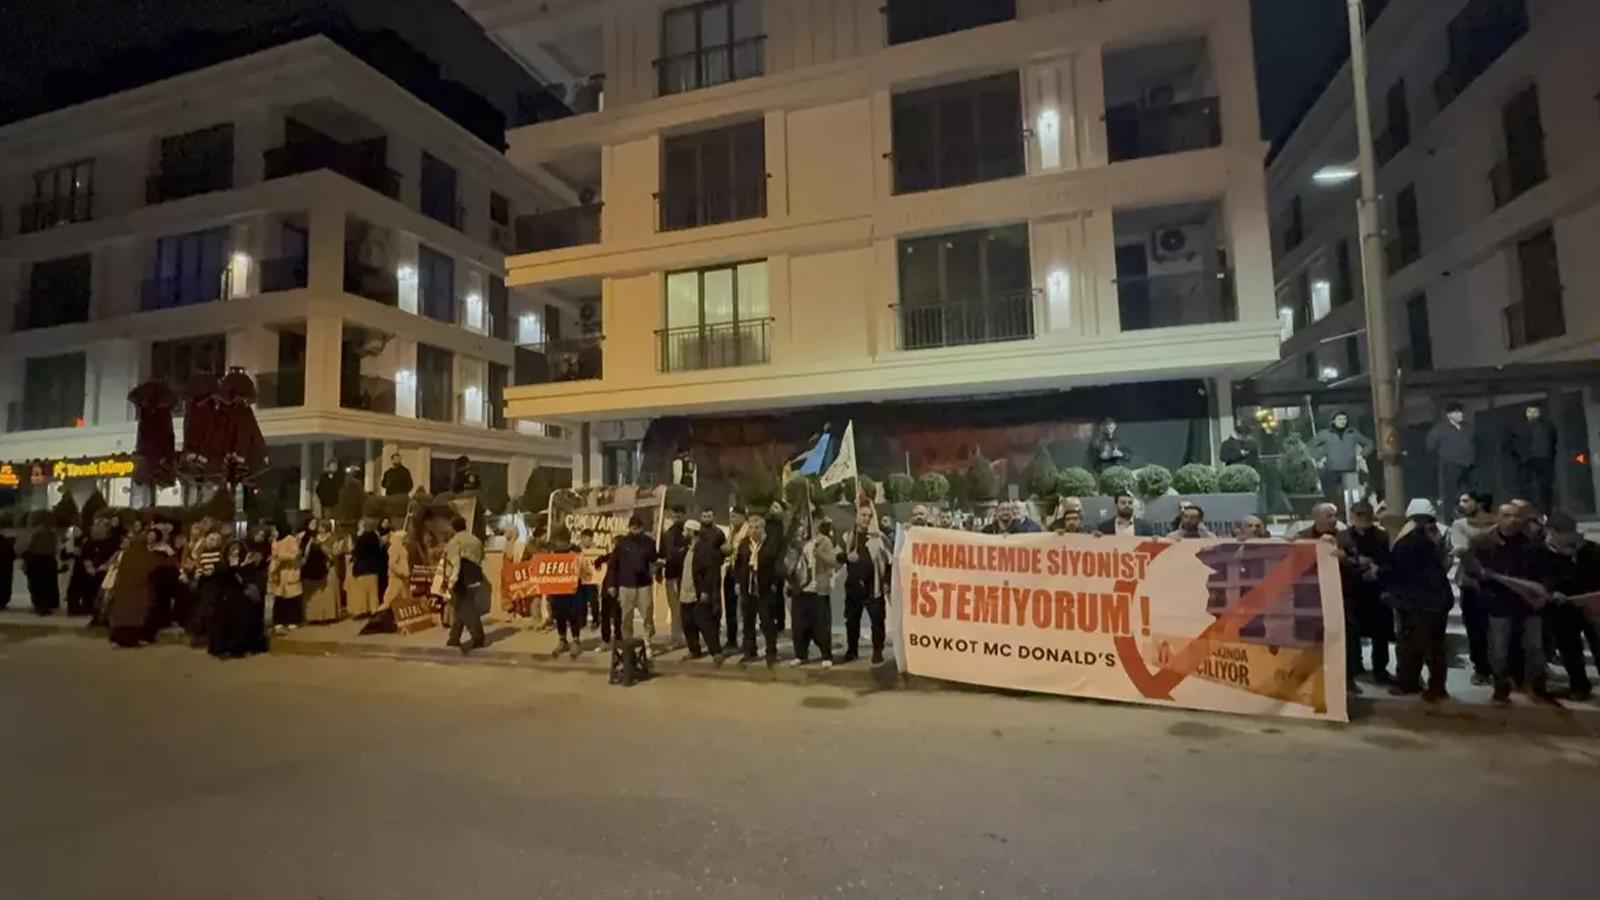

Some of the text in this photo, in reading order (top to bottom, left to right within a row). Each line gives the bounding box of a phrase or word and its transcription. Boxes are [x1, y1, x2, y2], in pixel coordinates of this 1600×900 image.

[911, 542, 1149, 580] MAHALLEMDE SİYONİST
[910, 571, 1130, 636] İSTEMİYORUM
[909, 633, 1116, 668] BOYKOT MC DONALD'S
